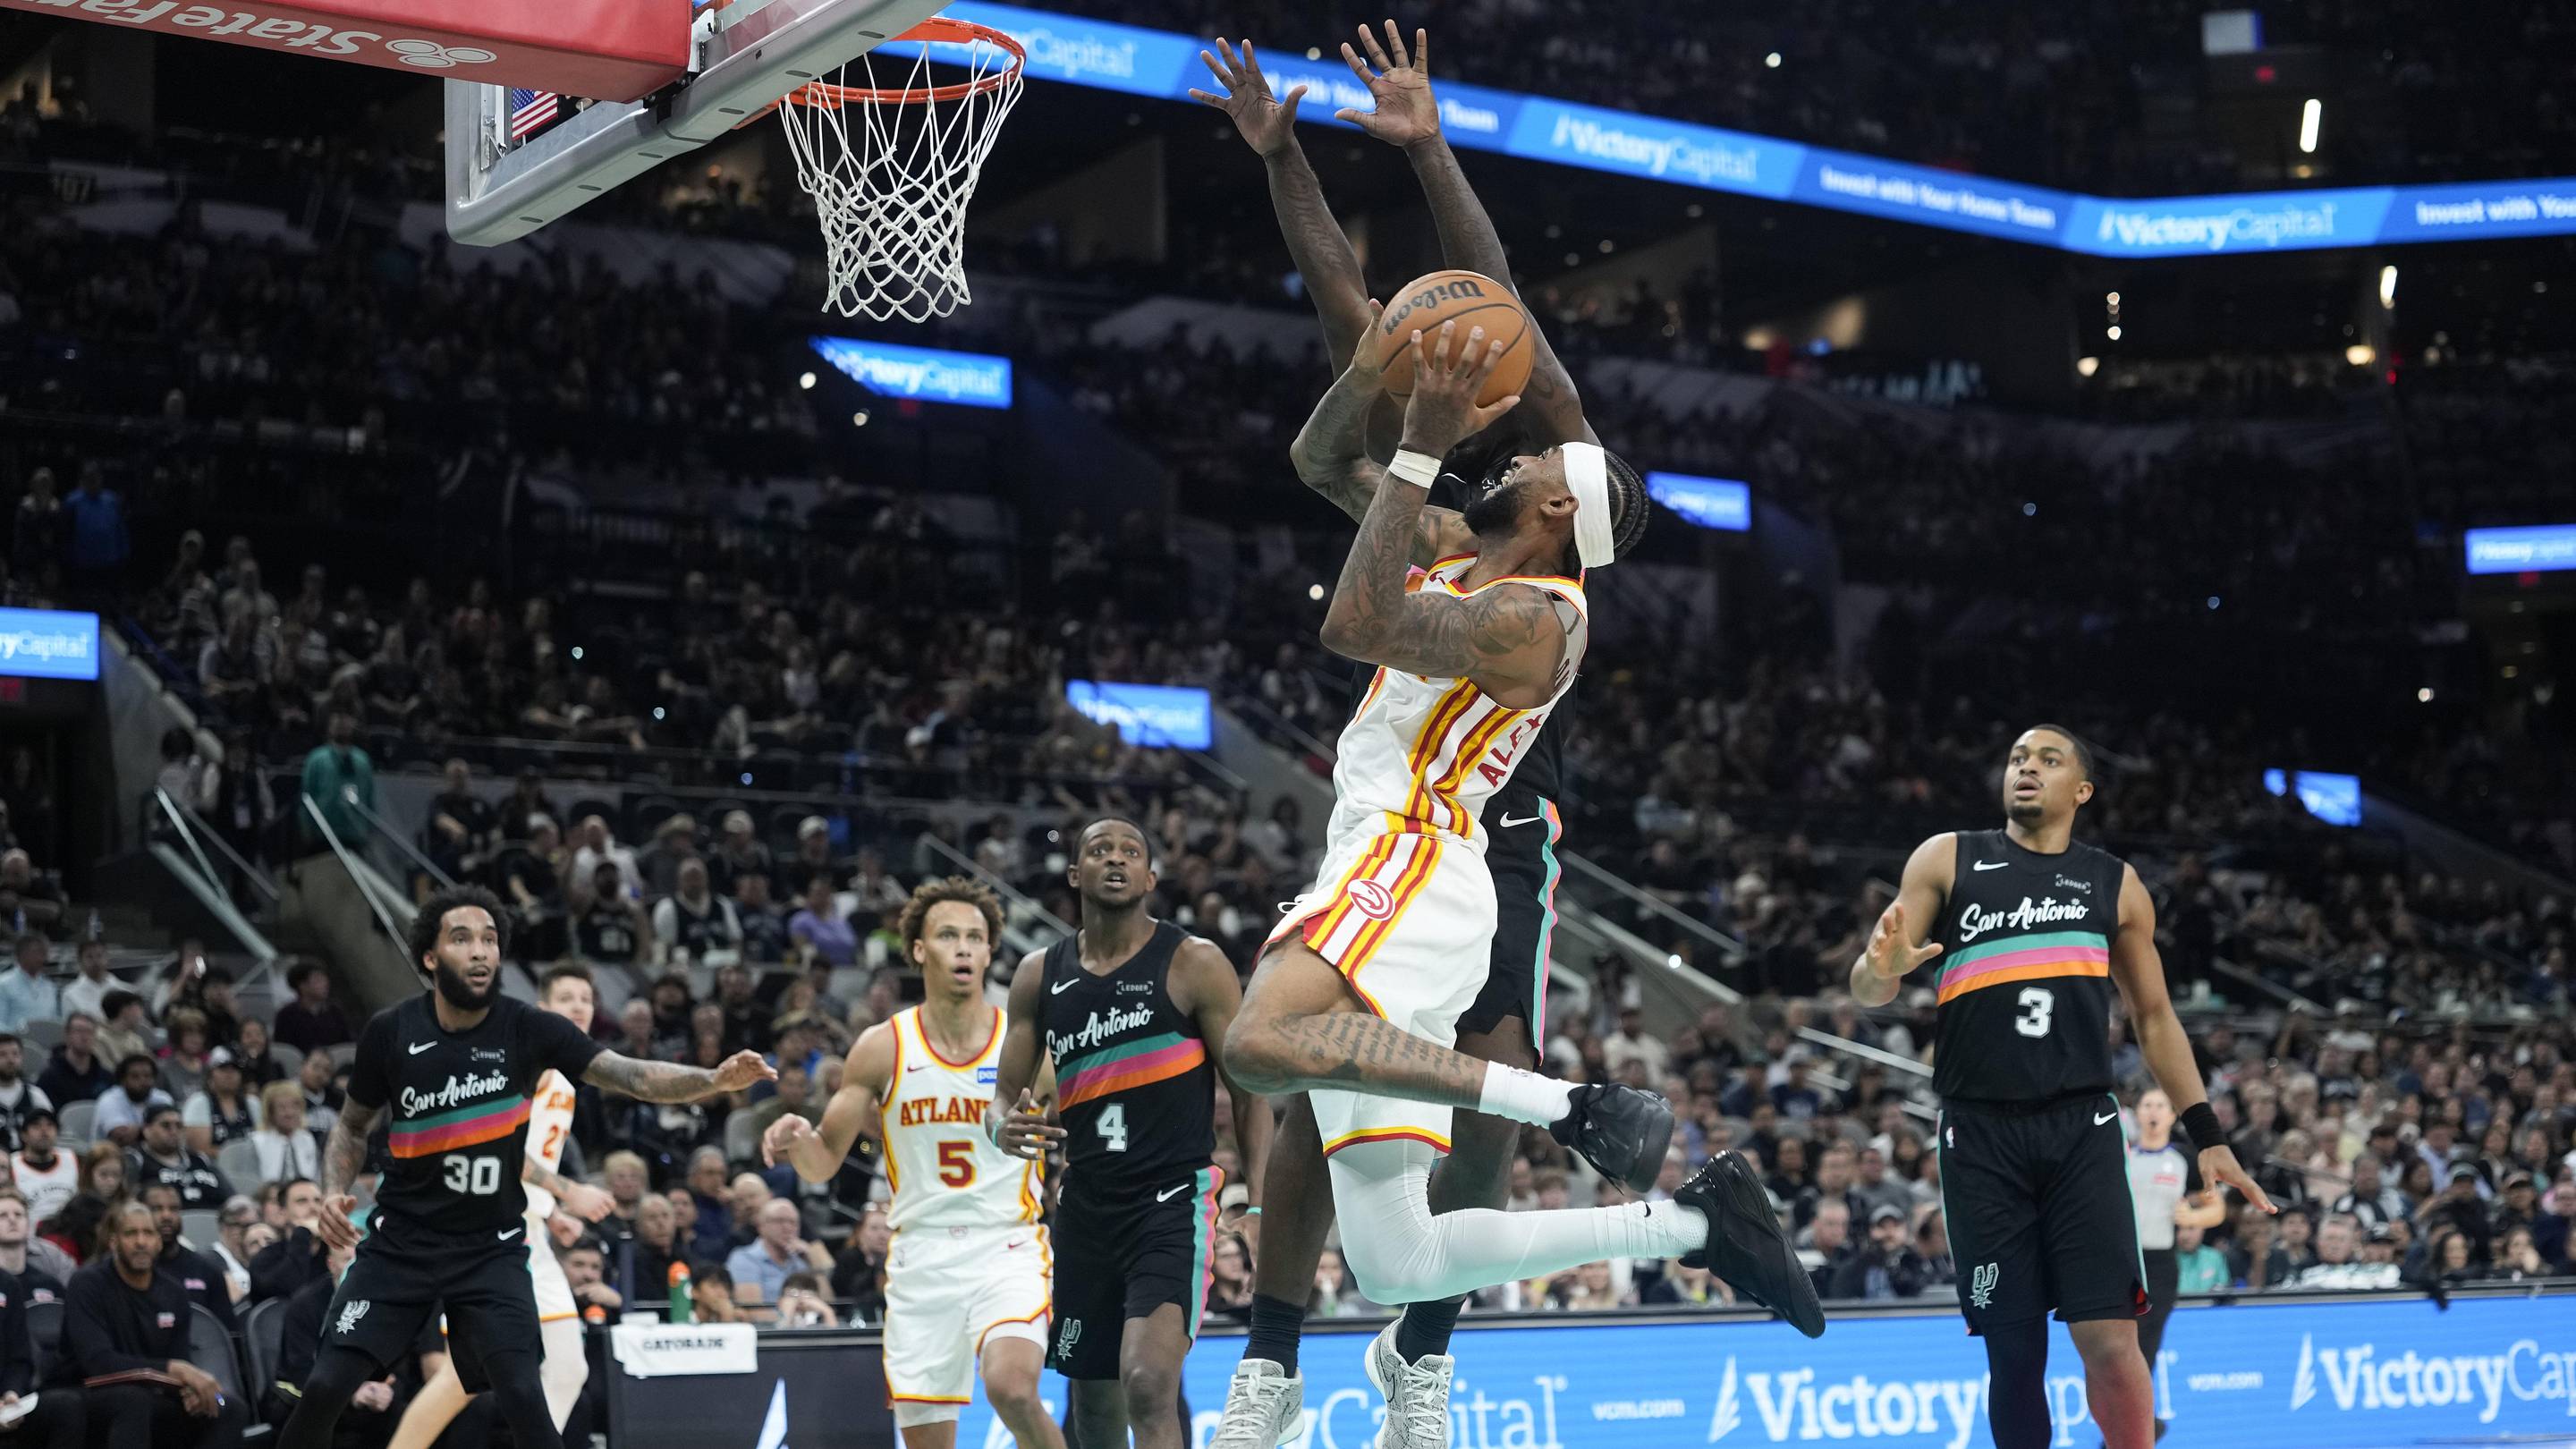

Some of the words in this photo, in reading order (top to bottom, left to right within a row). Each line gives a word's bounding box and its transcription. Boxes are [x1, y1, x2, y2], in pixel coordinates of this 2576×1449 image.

[2416, 198, 2486, 226] Invest
[2486, 195, 2538, 222] with
[2537, 192, 2576, 219] You
[1385, 279, 1486, 335] Wilson
[1960, 902, 2005, 943] San
[2006, 896, 2089, 930] Antonio
[1046, 1029, 1075, 1066] San
[1076, 1002, 1155, 1047] Antonio
[2015, 987, 2055, 1039] 3
[401, 1086, 436, 1119] San
[436, 1069, 509, 1108] Antonio
[1095, 1102, 1129, 1153] 4
[443, 1153, 503, 1196] 30
[937, 1139, 979, 1189] 5
[1591, 1398, 1686, 1421] vcm.com
